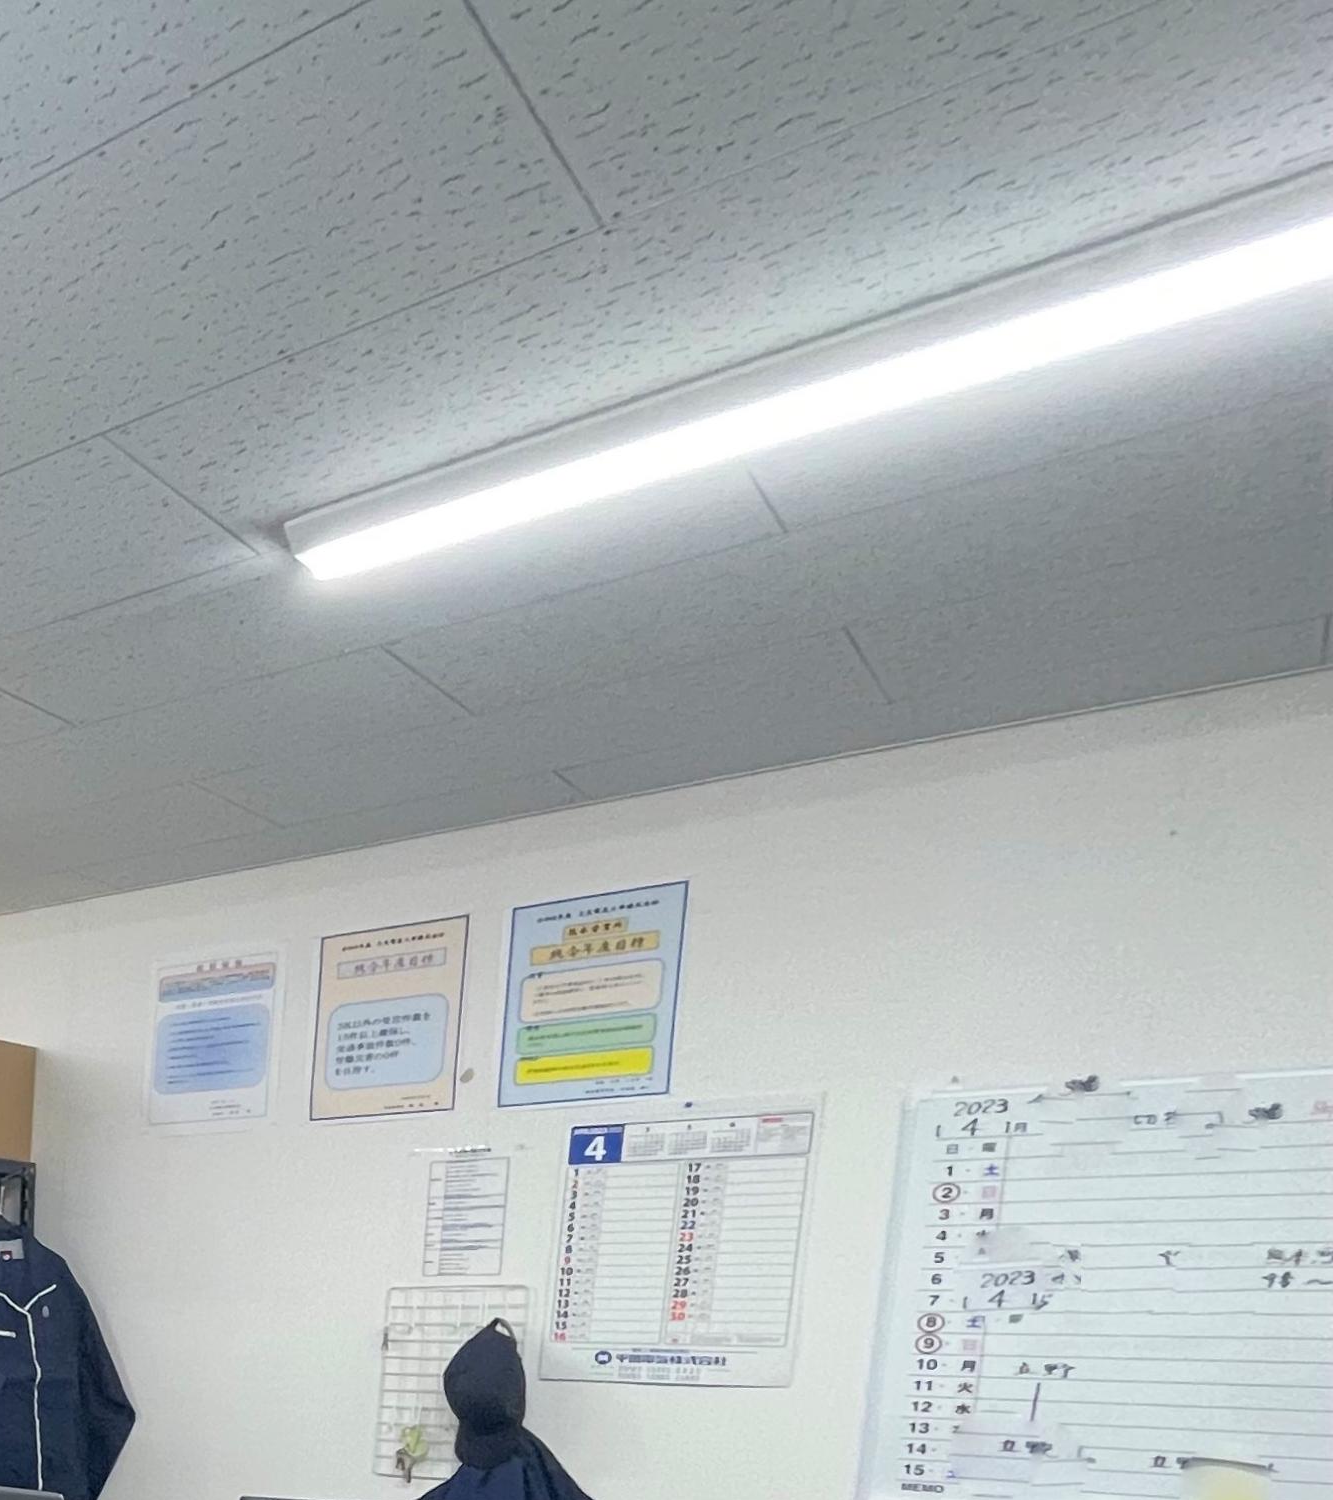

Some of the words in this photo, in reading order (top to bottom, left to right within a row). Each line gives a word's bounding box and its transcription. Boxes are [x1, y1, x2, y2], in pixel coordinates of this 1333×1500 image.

[954, 1098, 1009, 1117] 2023
[961, 1117, 980, 1136] 4
[584, 1135, 607, 1161] 4
[947, 1166, 953, 1176] 1
[983, 1163, 1000, 1176] 土
[938, 1209, 950, 1220] 3
[936, 1230, 947, 1241] 4
[676, 1255, 692, 1264] 25
[934, 1252, 944, 1263] 5
[675, 1266, 691, 1276] 26
[674, 1278, 689, 1287] 27
[931, 1273, 942, 1285] 6
[979, 1270, 1036, 1288] 2023
[672, 1289, 688, 1298] 28
[929, 1295, 940, 1306] 7
[917, 1358, 938, 1371] 10
[961, 1360, 976, 1372] 月
[914, 1380, 933, 1391] 11
[957, 1382, 973, 1393] 火
[911, 1401, 933, 1413] 12
[909, 1422, 930, 1434] 13
[907, 1443, 927, 1454] 14
[904, 1464, 925, 1476] 15
[900, 1483, 945, 1493] MEMO
